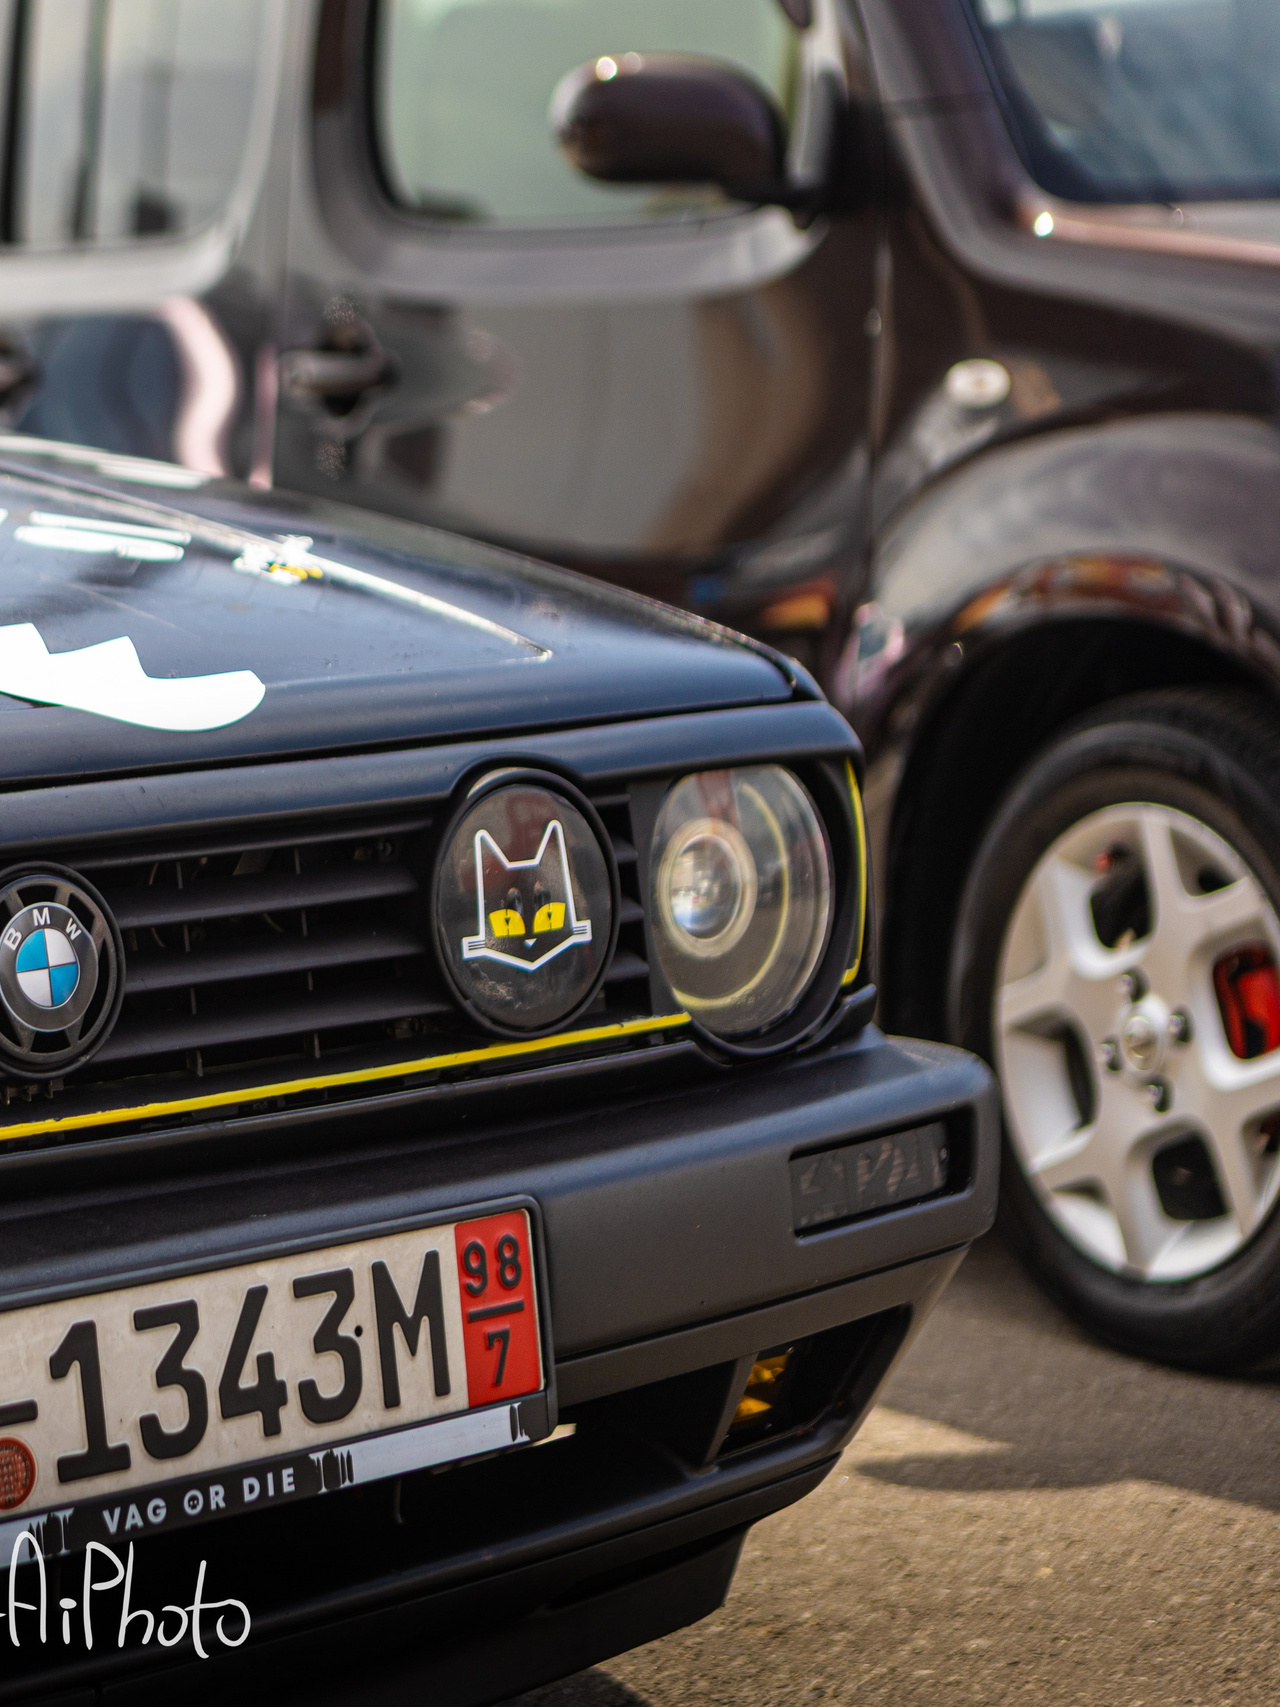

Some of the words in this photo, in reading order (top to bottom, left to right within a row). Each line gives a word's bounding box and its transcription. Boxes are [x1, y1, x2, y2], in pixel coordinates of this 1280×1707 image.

[4, 907, 81, 950] BMW
[463, 1233, 522, 1295] 98
[487, 1327, 510, 1386] 7
[102, 1497, 167, 1535] VAG
[183, 1484, 226, 1516] OR
[242, 1467, 296, 1503] DIE
